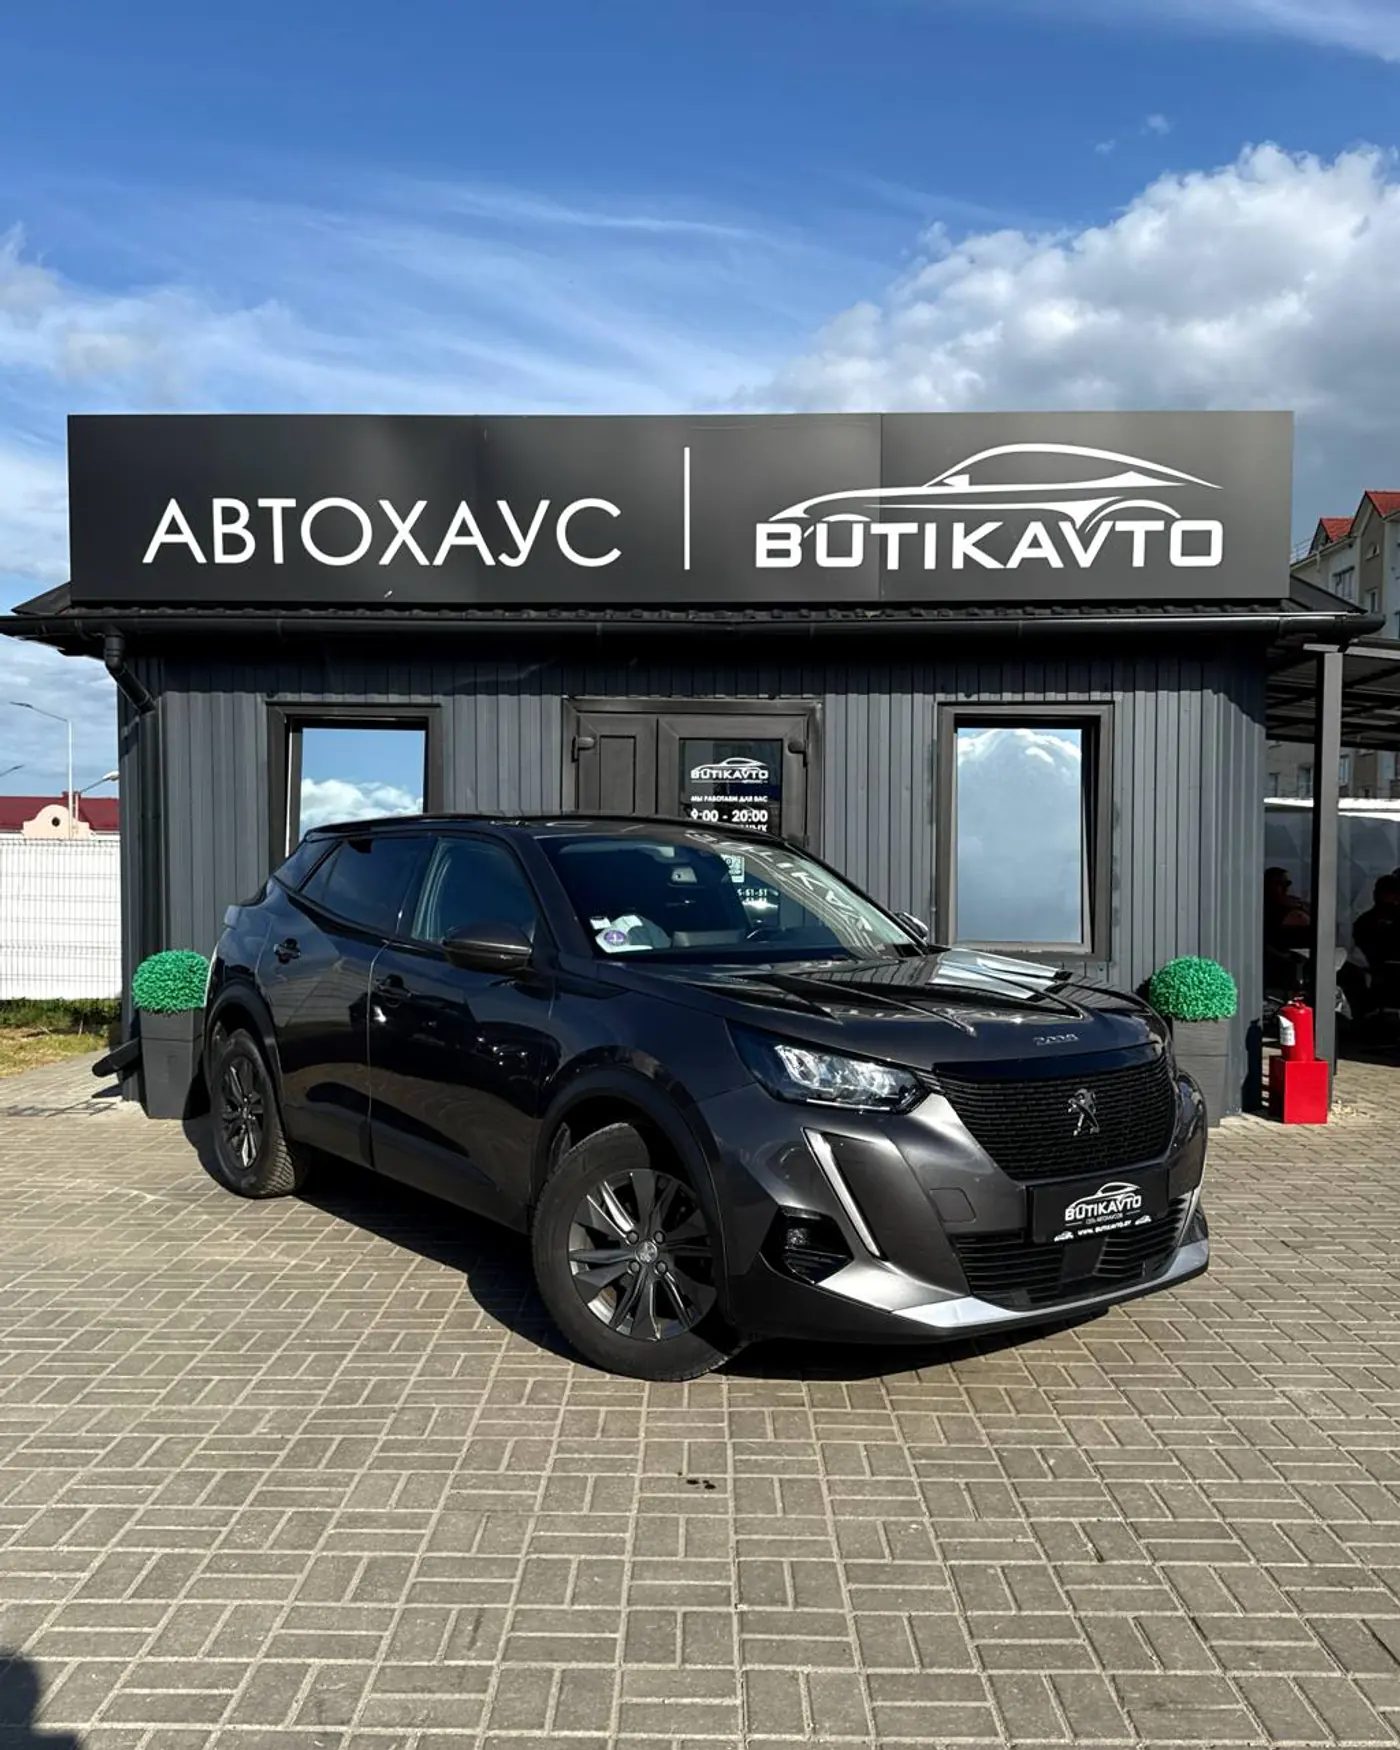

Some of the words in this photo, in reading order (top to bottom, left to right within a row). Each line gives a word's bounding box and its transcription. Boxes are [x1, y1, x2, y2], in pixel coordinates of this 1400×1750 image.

[143, 498, 622, 568] АВТОХАУС
[755, 519, 1224, 570] BUTIKAVTO
[691, 769, 769, 780] BUTIKAVTO
[754, 795, 768, 803] ВАС
[731, 809, 769, 823] 20:00
[1064, 1195, 1142, 1221] BUTIKAVTO
